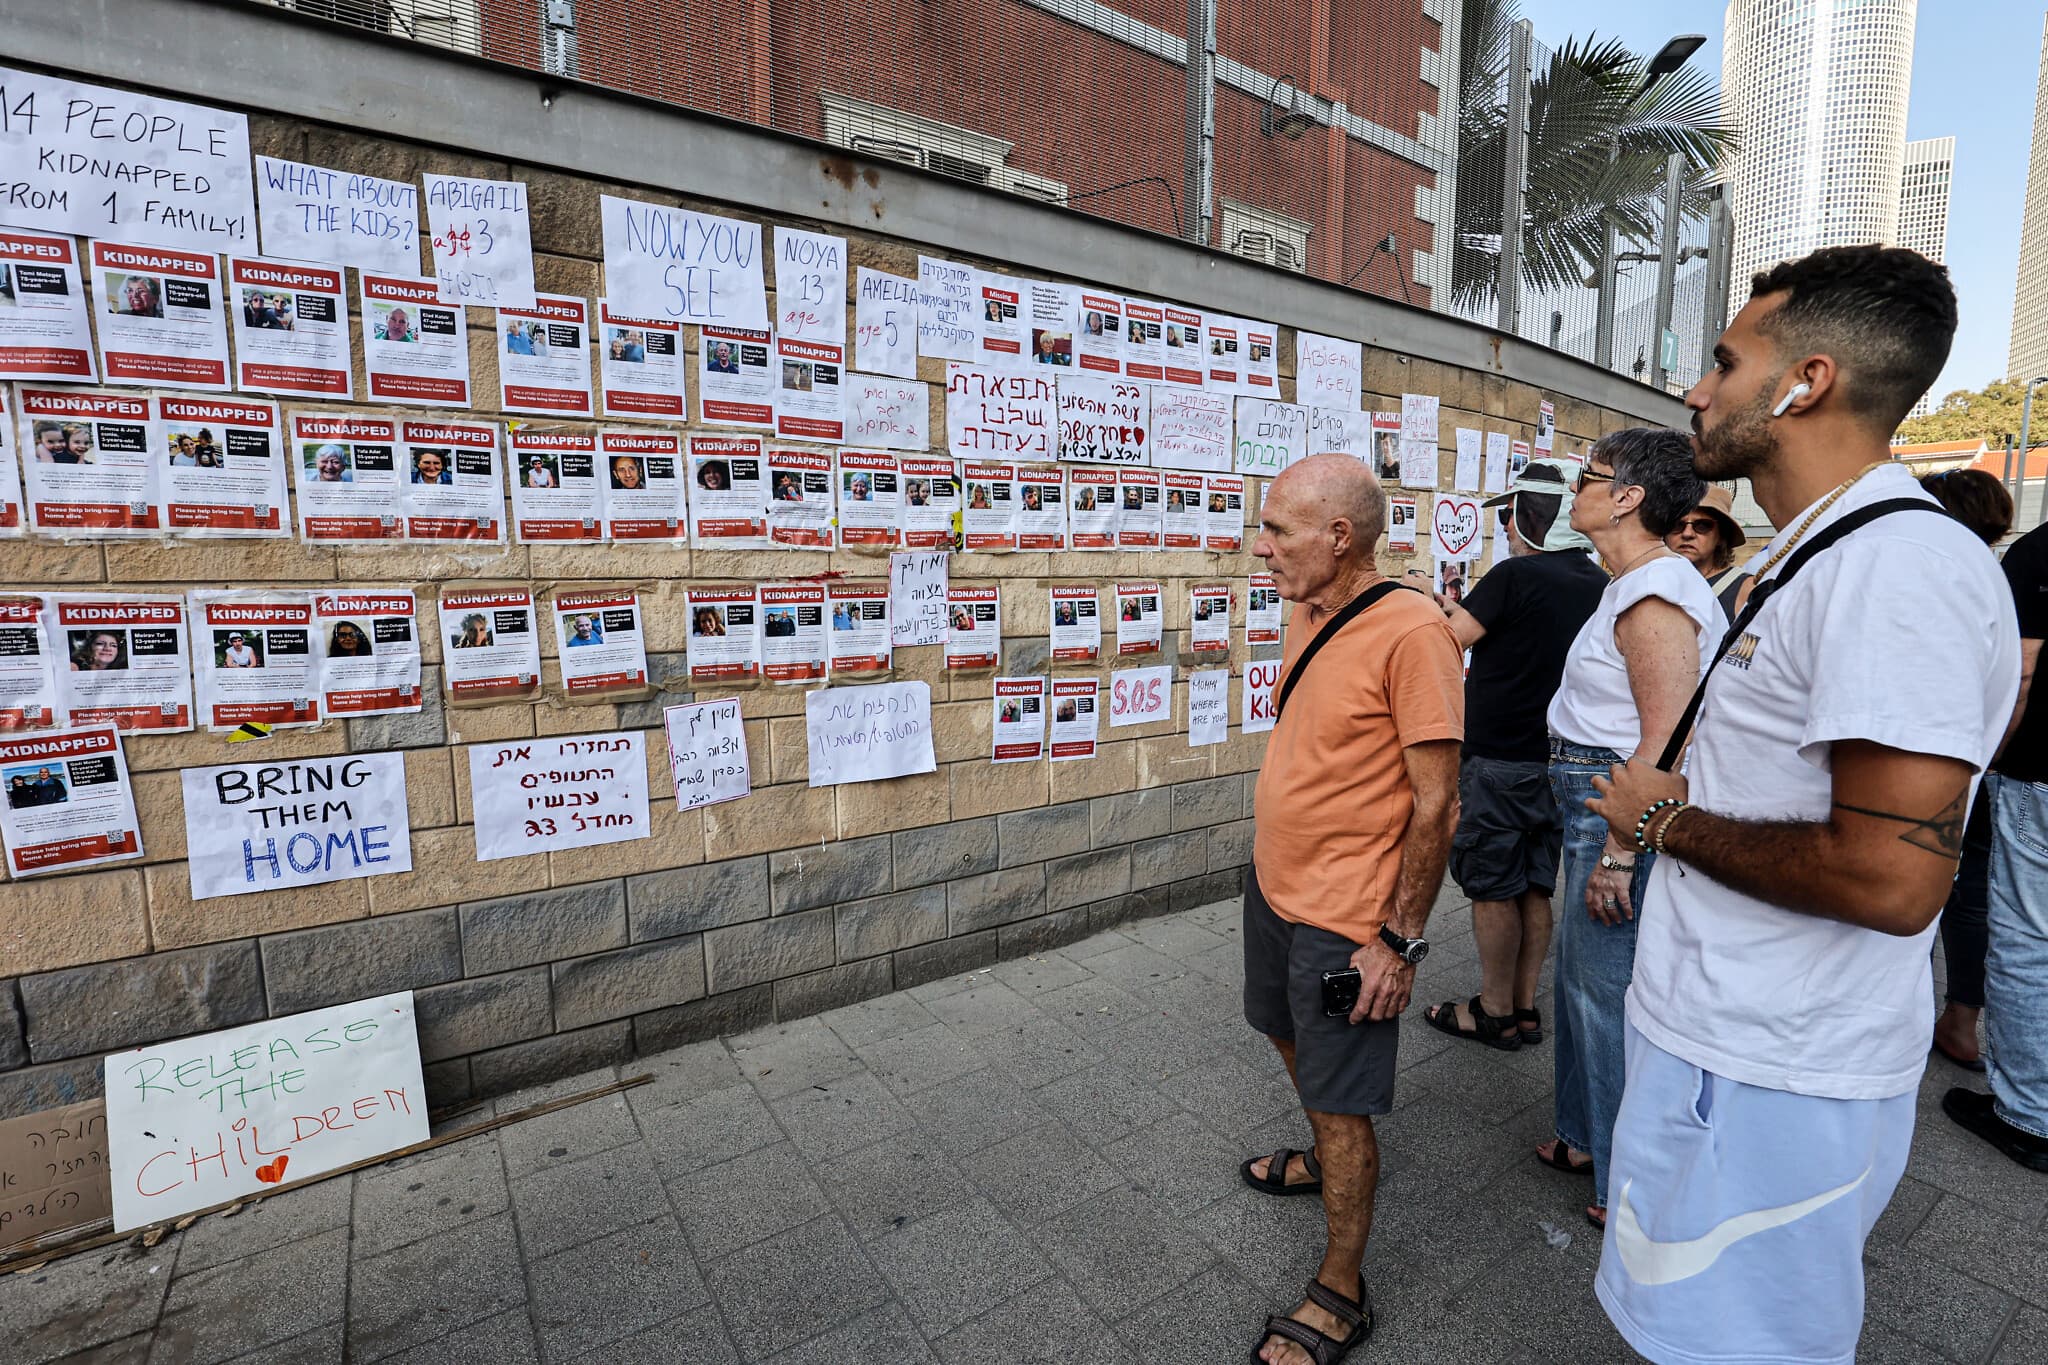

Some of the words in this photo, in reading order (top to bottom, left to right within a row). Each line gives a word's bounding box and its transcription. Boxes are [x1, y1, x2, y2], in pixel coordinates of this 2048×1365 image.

[0, 86, 40, 135] 14
[65, 100, 226, 157] PEOPLE
[39, 147, 210, 193] KIDNAPPED
[265, 161, 336, 200] WHAT
[348, 175, 415, 208] ABOUT
[430, 180, 523, 212] ABIGAIL
[102, 192, 117, 224] 1
[145, 201, 244, 239] FAMILY!
[296, 204, 341, 232] THE
[352, 208, 413, 250] KIDS?
[477, 219, 493, 254] 3
[626, 206, 688, 260] NOW
[697, 219, 754, 268] YOU
[104, 250, 207, 273] KIDNAPPED
[784, 237, 838, 270] NOYA
[241, 267, 334, 288] KIDNAPPED
[665, 265, 726, 317] SEE
[800, 274, 824, 305] 13
[862, 277, 918, 306] AMELIA
[989, 290, 1012, 302] Missing
[1085, 299, 1119, 312] KIDNAPPED
[1128, 308, 1161, 320] KIDNAPPED
[1166, 310, 1199, 323] KIDNAPPED
[785, 311, 820, 334] age
[858, 326, 881, 346] age
[885, 311, 898, 346] 5
[783, 344, 838, 359] KIDNAPPED
[1667, 336, 1674, 365] 7
[948, 373, 1050, 401] תפארת
[1112, 384, 1140, 399] ביבי
[31, 396, 143, 414] KIDNAPPED
[166, 403, 268, 422] KIDNAPPED
[981, 402, 1043, 426] שלנו
[301, 422, 390, 436] KIDNAPPED
[1312, 407, 1343, 439] Bring
[408, 428, 490, 442] KIDNAPPED
[516, 436, 591, 446] KIDNAPPED
[958, 427, 1046, 452] נעדרת
[1324, 434, 1351, 451] them
[607, 438, 674, 449] KIDNAPPED
[695, 442, 757, 452] KIDNAPPED
[771, 454, 828, 468] KIDNAPPED
[843, 456, 896, 467] KIDNAPPED
[903, 463, 952, 473] KIDNAPPED
[966, 468, 1011, 477] KIDNAPPED
[1020, 471, 1060, 480] KIDNAPPED
[1074, 472, 1114, 481] KIDNAPPED
[1122, 473, 1158, 482] KIDNAPPED
[1166, 476, 1202, 486] KIDNAPPED
[1209, 479, 1242, 490] KIDNAPPED
[447, 592, 525, 605] KIDNAPPED
[691, 590, 753, 599] KIDNAPPED
[764, 590, 822, 600] KIDNAPPED
[831, 586, 885, 596] KIDNAPPED
[949, 590, 995, 598] KIDNAPPED
[1054, 587, 1095, 595] KIDNAPPED
[320, 600, 409, 612] KIDNAPPED
[560, 594, 631, 606] KIDNAPPED
[66, 607, 176, 620] KIDNAPPED
[211, 609, 307, 621] KIDNAPPED
[999, 684, 1039, 693] KIDNAPPED
[1056, 685, 1094, 693] KIDNAPPED
[1192, 678, 1219, 691] MOMMY
[1191, 699, 1219, 711] WHERE
[1192, 714, 1209, 725] ARE
[0, 736, 110, 758] KIDNAPPED
[559, 739, 631, 757] תחזירו
[493, 746, 531, 768] את
[216, 760, 372, 804] BRING
[520, 768, 614, 789] החטופים
[528, 791, 600, 811] עכשיו
[248, 800, 352, 828] THEM
[571, 812, 633, 832] מחדל
[524, 817, 558, 838] 23
[21, 847, 44, 856] Please
[44, 845, 60, 854] help
[61, 843, 79, 852] bring
[80, 840, 97, 848] them
[243, 825, 391, 882] HOME
[22, 854, 42, 862] home
[126, 1018, 379, 1102] RELEASE
[199, 1068, 306, 1113] THE
